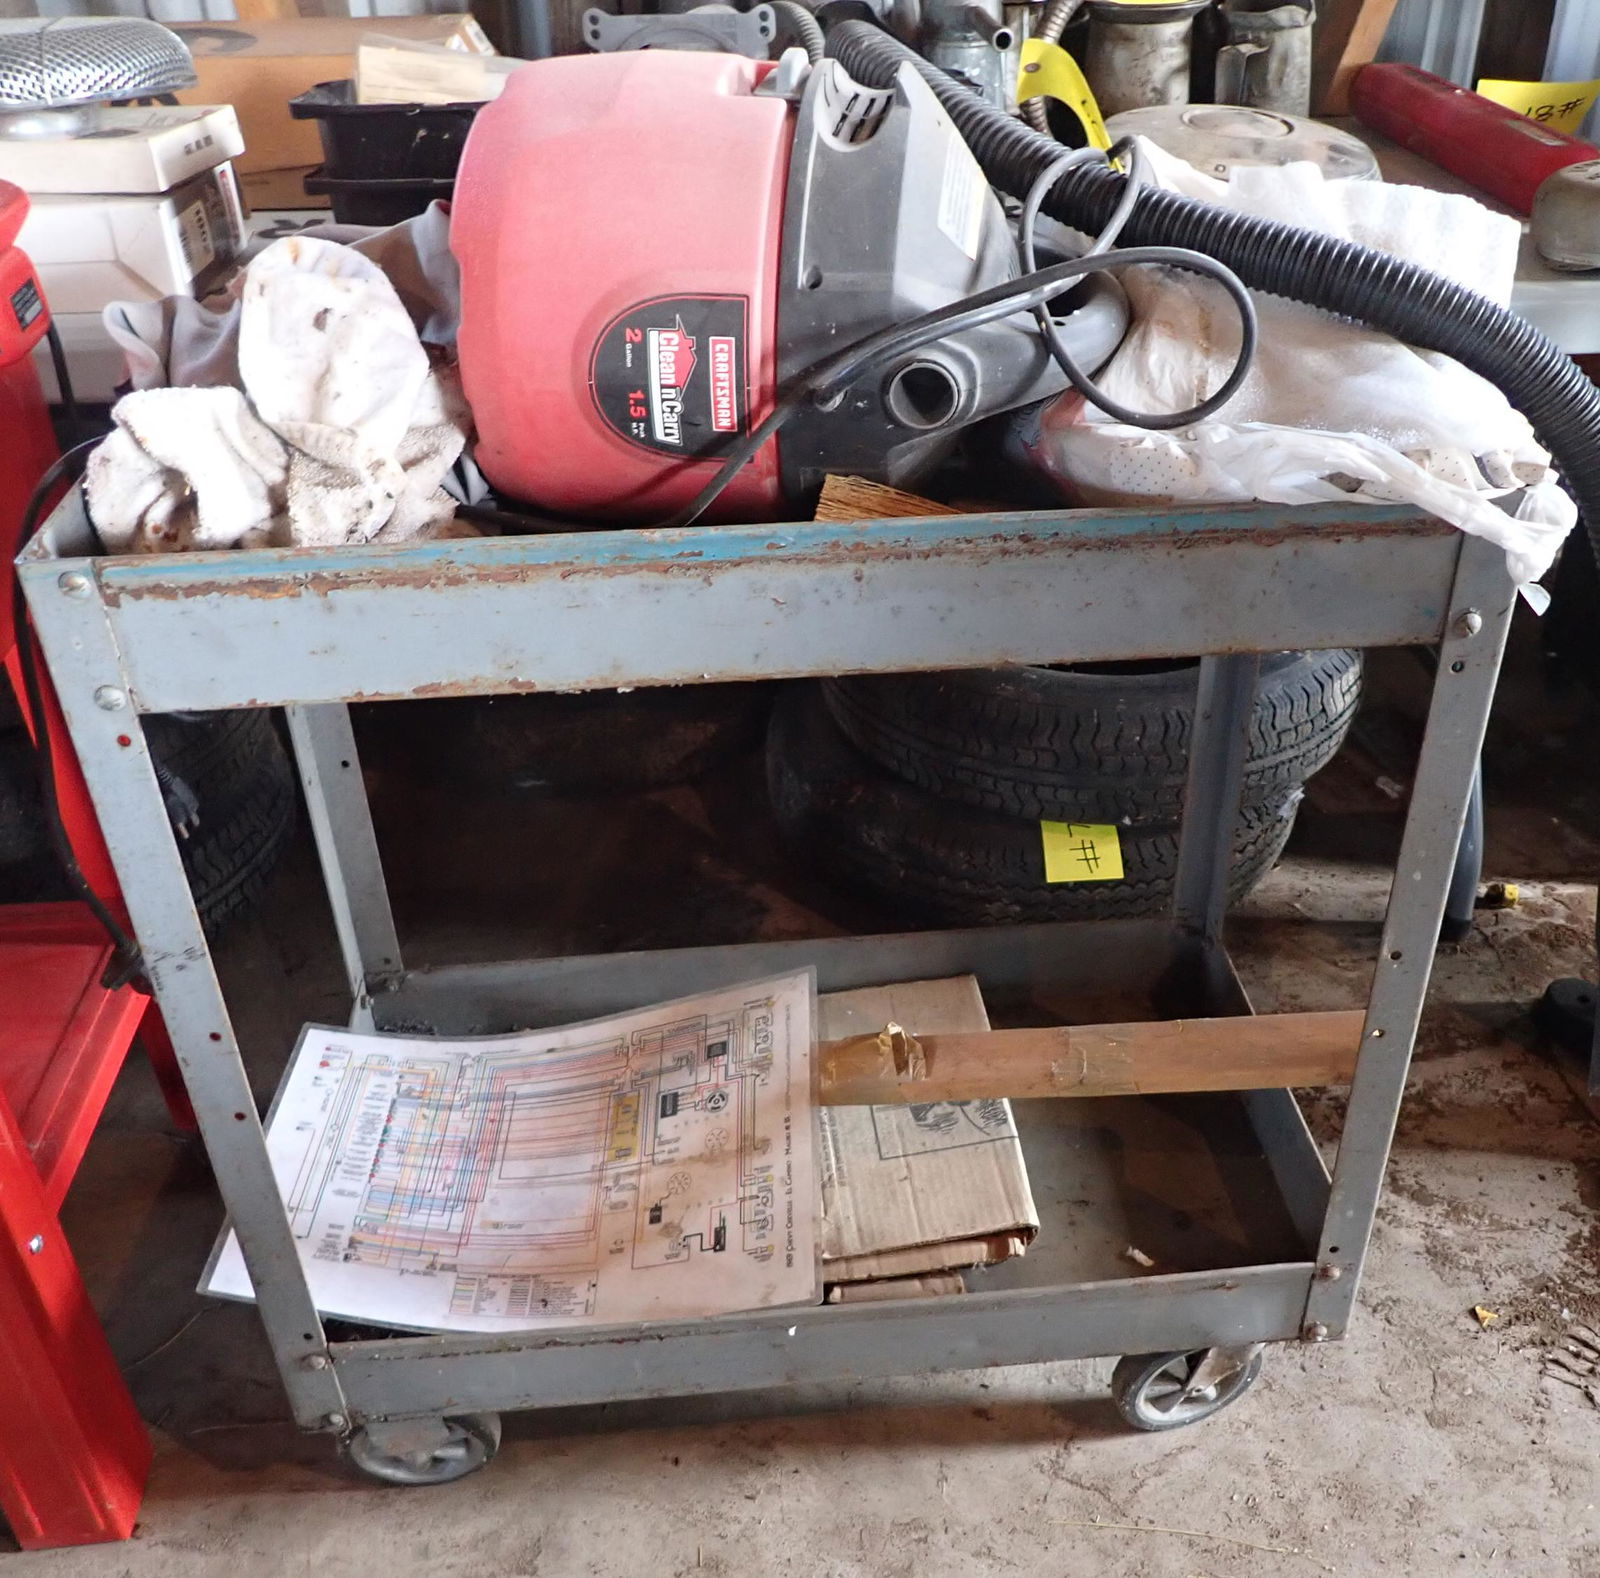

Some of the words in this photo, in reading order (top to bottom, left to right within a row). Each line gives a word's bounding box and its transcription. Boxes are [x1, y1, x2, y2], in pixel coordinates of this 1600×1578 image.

[625, 327, 642, 343] 2
[658, 332, 679, 385] Clean
[628, 389, 647, 418] 1.5
[714, 343, 732, 427] CRAFTSMAN
[662, 400, 682, 444] Carry
